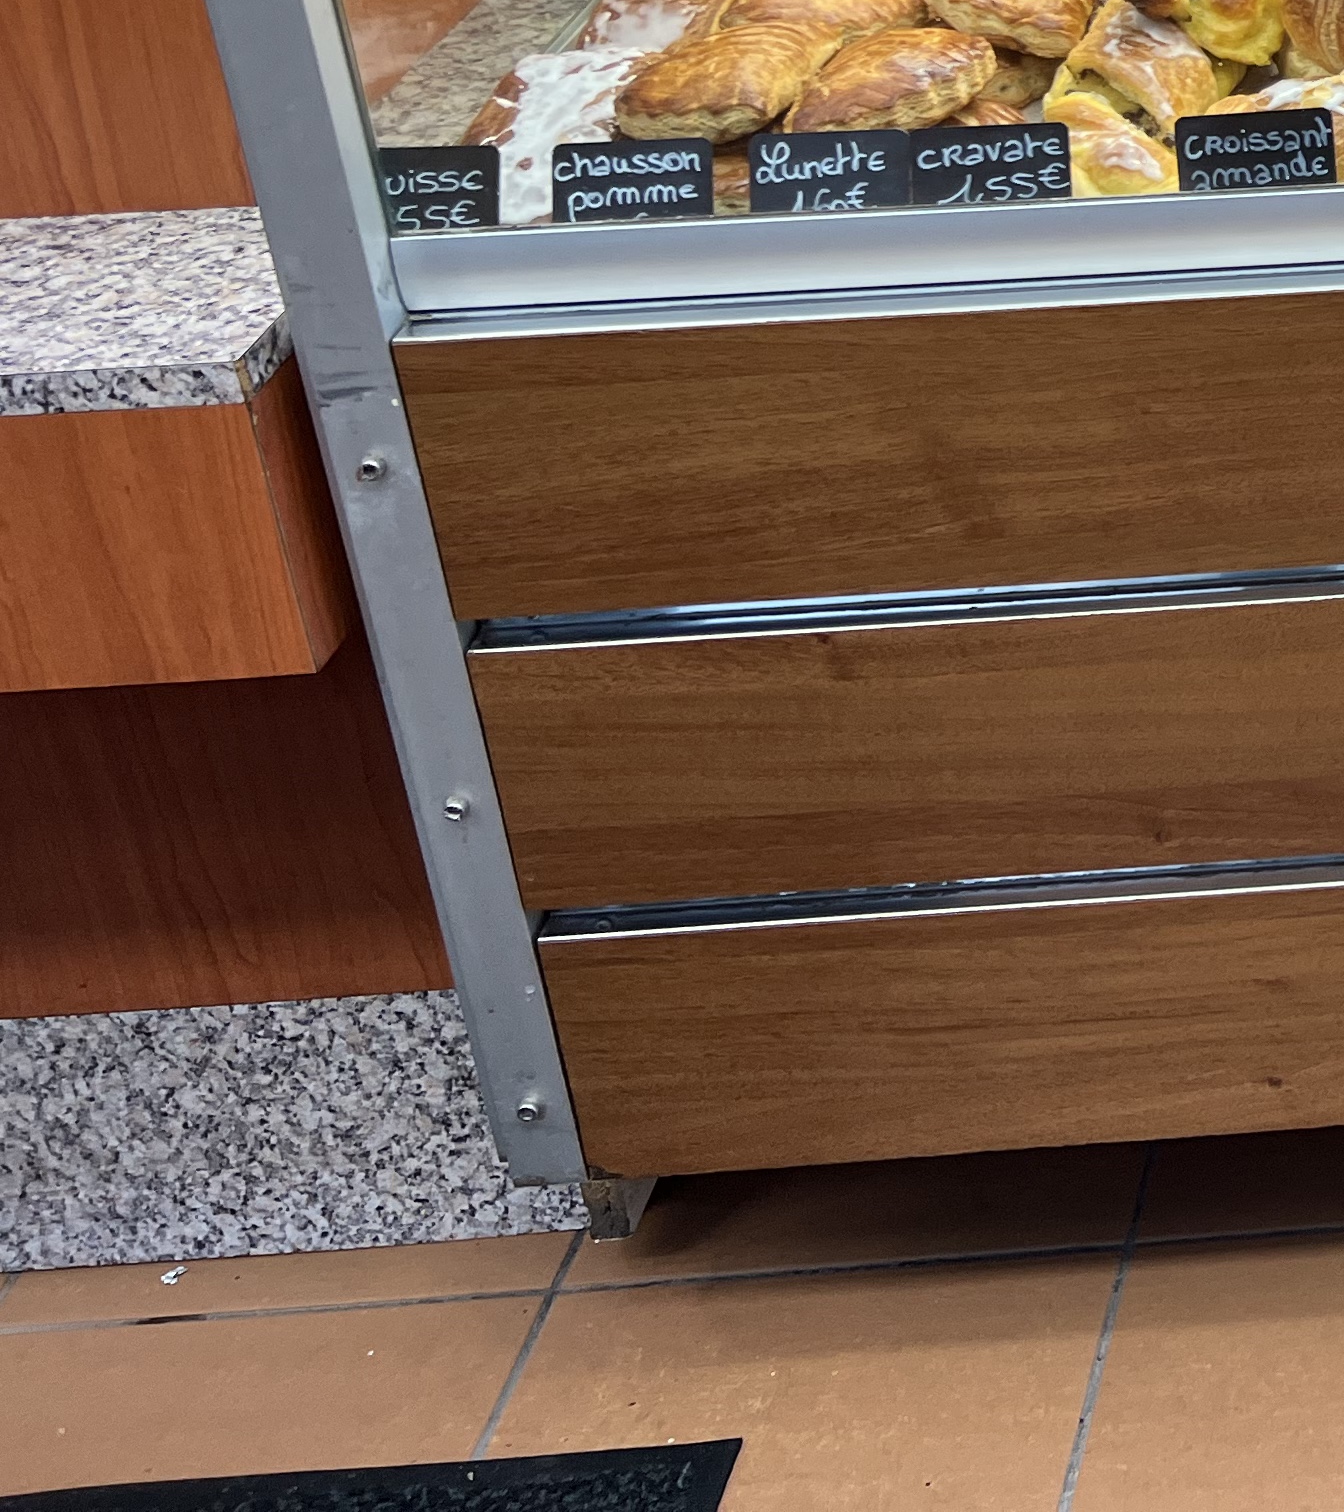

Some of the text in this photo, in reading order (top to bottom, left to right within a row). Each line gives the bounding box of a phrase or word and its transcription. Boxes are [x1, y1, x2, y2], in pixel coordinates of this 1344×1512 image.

[755, 140, 886, 184] Lunette
[1190, 151, 1329, 191] amande
[567, 182, 700, 222] pomme
[936, 162, 1070, 206] 1,55€
